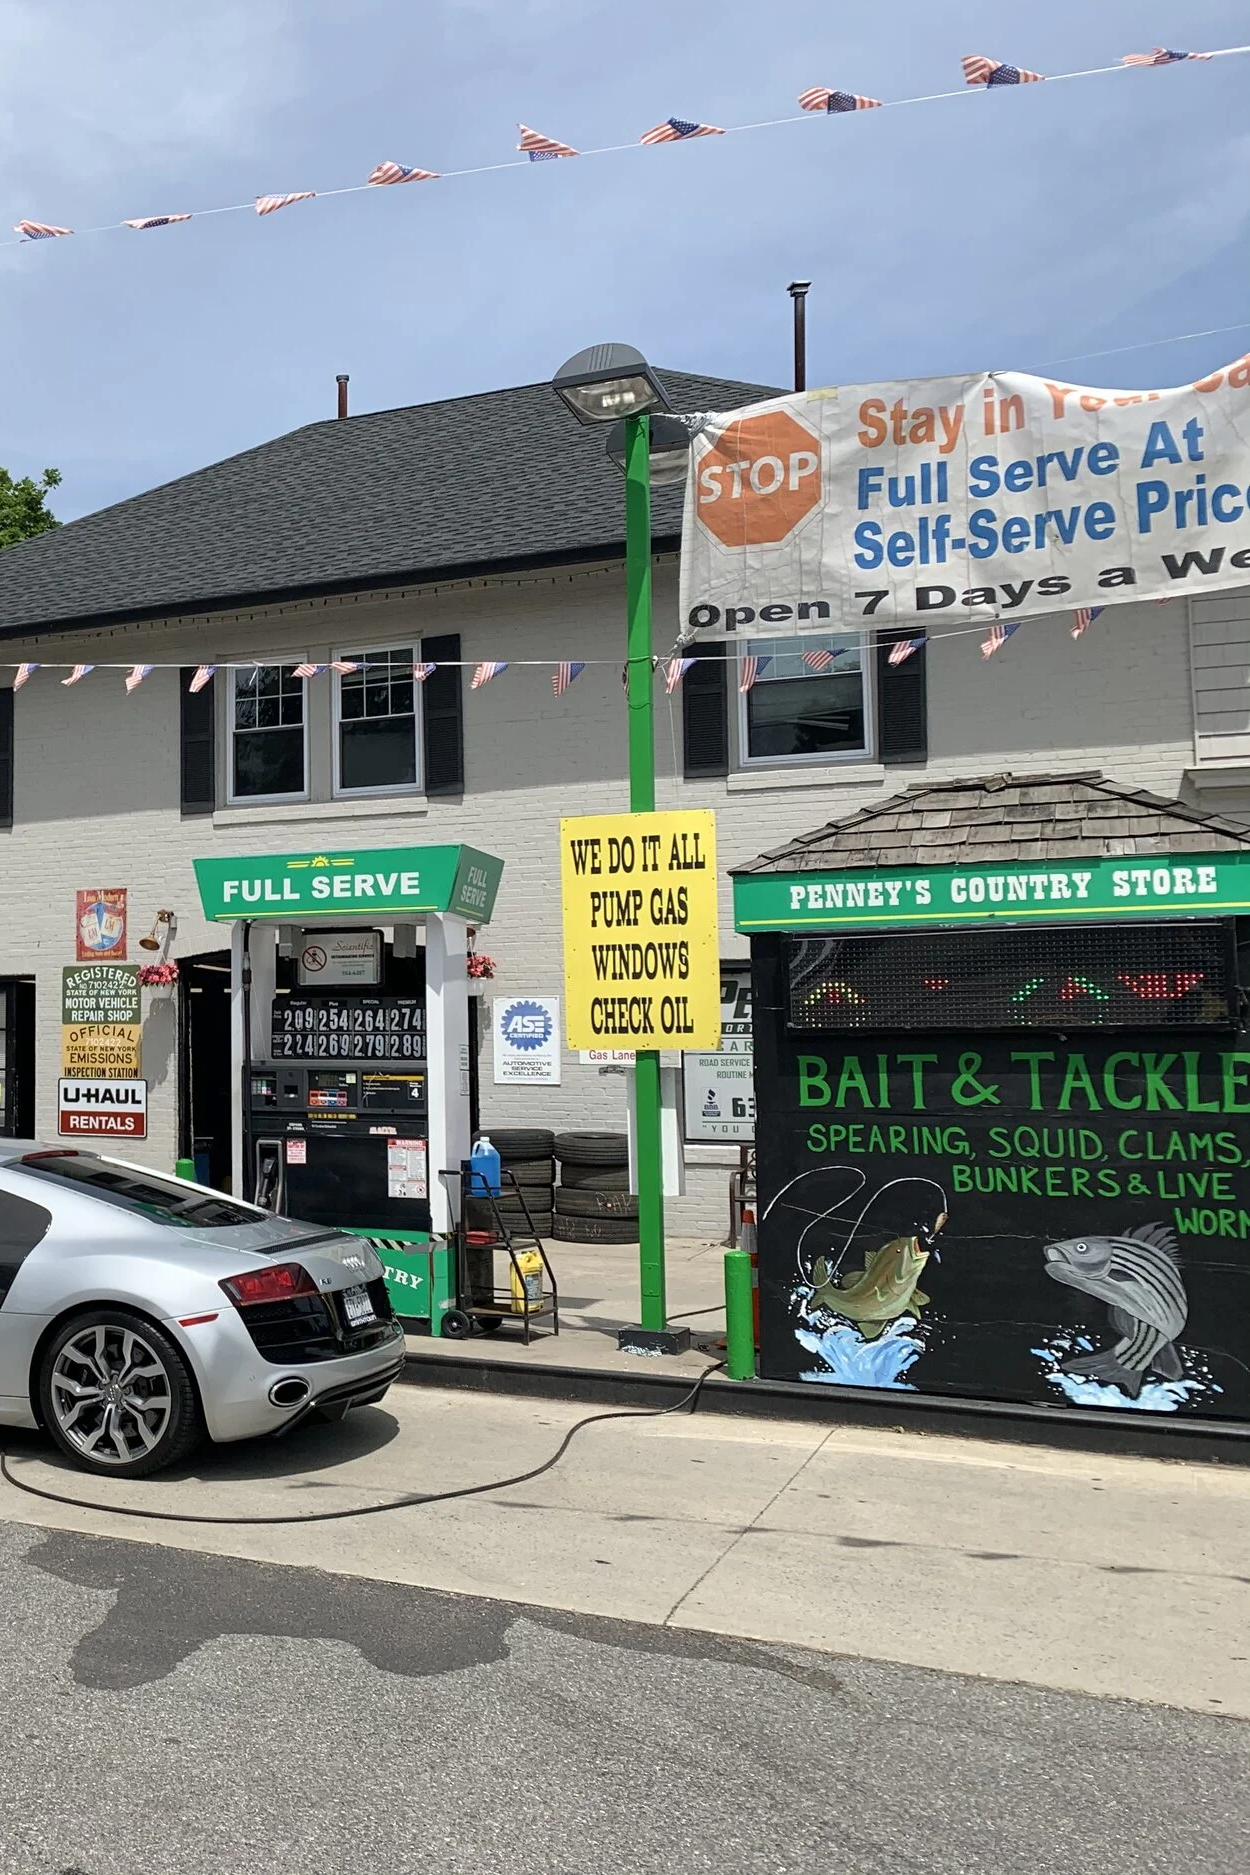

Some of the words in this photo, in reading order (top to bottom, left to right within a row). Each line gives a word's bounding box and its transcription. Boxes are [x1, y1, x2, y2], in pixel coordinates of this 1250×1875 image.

[857, 397, 967, 454] Stay
[983, 388, 1026, 436] in
[858, 460, 949, 510] Full
[968, 441, 1121, 498] Serve
[1140, 416, 1205, 469] At
[700, 451, 819, 504] STOP
[853, 501, 1117, 570] Self-Serve
[1136, 473, 1250, 534] Pric
[688, 600, 831, 632] Open
[854, 590, 890, 616] 7
[915, 575, 1073, 611] Days
[1097, 565, 1138, 589] a
[570, 838, 602, 875] WE
[608, 835, 635, 874] DO
[641, 835, 661, 872] IT
[668, 832, 706, 871] ALL
[223, 878, 300, 903] FULL
[311, 872, 420, 899] SERVE
[467, 866, 488, 889] FULL
[789, 879, 932, 910] PENNEY'S
[950, 872, 1092, 904] COUNTRY
[1112, 866, 1218, 897] STORE
[460, 885, 488, 908] SERVE
[590, 889, 643, 928] PUMP
[650, 886, 689, 926] GAS
[591, 940, 689, 981] WINDOWS
[66, 966, 137, 989] REGISTERED
[65, 998, 96, 1009] MOTOR
[98, 997, 139, 1009] VEHICLE
[71, 1010, 105, 1022] REPAIR
[107, 1010, 133, 1022] SHOP
[506, 1015, 545, 1033] ASE
[590, 996, 655, 1035] CHECK
[660, 995, 695, 1035] OIL
[69, 1024, 135, 1043] OFFICIAL
[69, 1052, 133, 1064] EMISSIONS
[589, 1050, 608, 1061] Gas
[612, 1050, 636, 1061] Lane
[699, 1058, 719, 1067] ROAD
[720, 1058, 751, 1067] SERVICE
[64, 1067, 107, 1078] INSPECTION
[108, 1067, 139, 1078] STATION
[716, 1071, 747, 1079] ROUTINE
[796, 1053, 939, 1110] BAIT
[951, 1051, 1001, 1106] &
[1010, 1051, 1250, 1113] TACKLE
[63, 1087, 142, 1104] U-HAUL
[411, 1087, 420, 1098] 4
[69, 1115, 135, 1131] RENTALS
[806, 1123, 977, 1161] SPEARING,
[988, 1125, 1109, 1162] SQUID,
[1118, 1129, 1250, 1168] CLAMS,
[952, 1164, 1122, 1198] BUNKERS
[1127, 1173, 1151, 1195] &
[1156, 1170, 1237, 1200] LIVE
